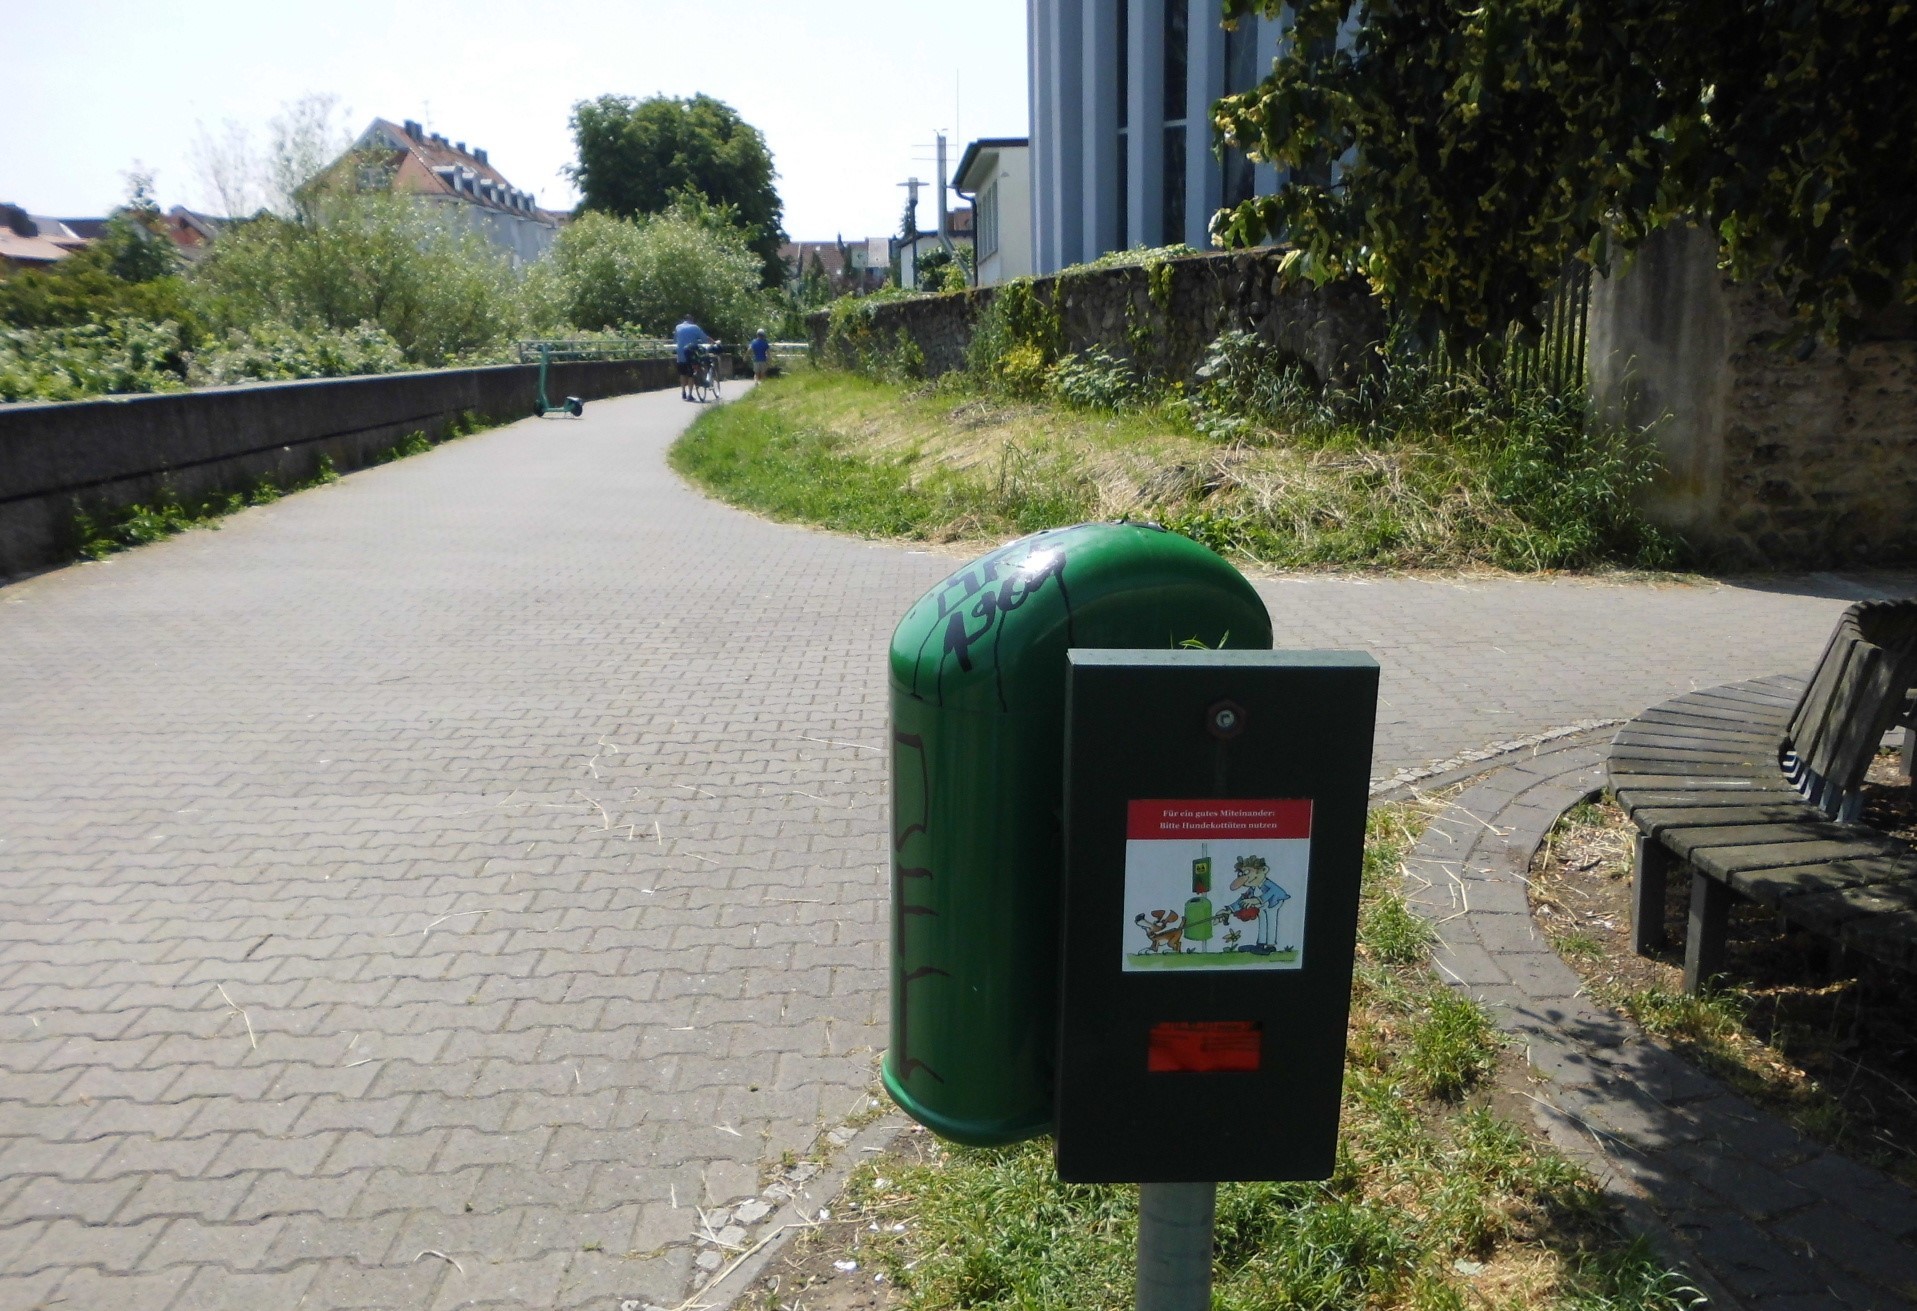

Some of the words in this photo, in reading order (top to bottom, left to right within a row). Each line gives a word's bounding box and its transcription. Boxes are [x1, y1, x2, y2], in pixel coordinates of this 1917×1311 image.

[1163, 809, 1177, 817] Für
[1180, 809, 1193, 817] ein
[1195, 810, 1218, 818] gutes
[1220, 809, 1275, 817] Miteinander:
